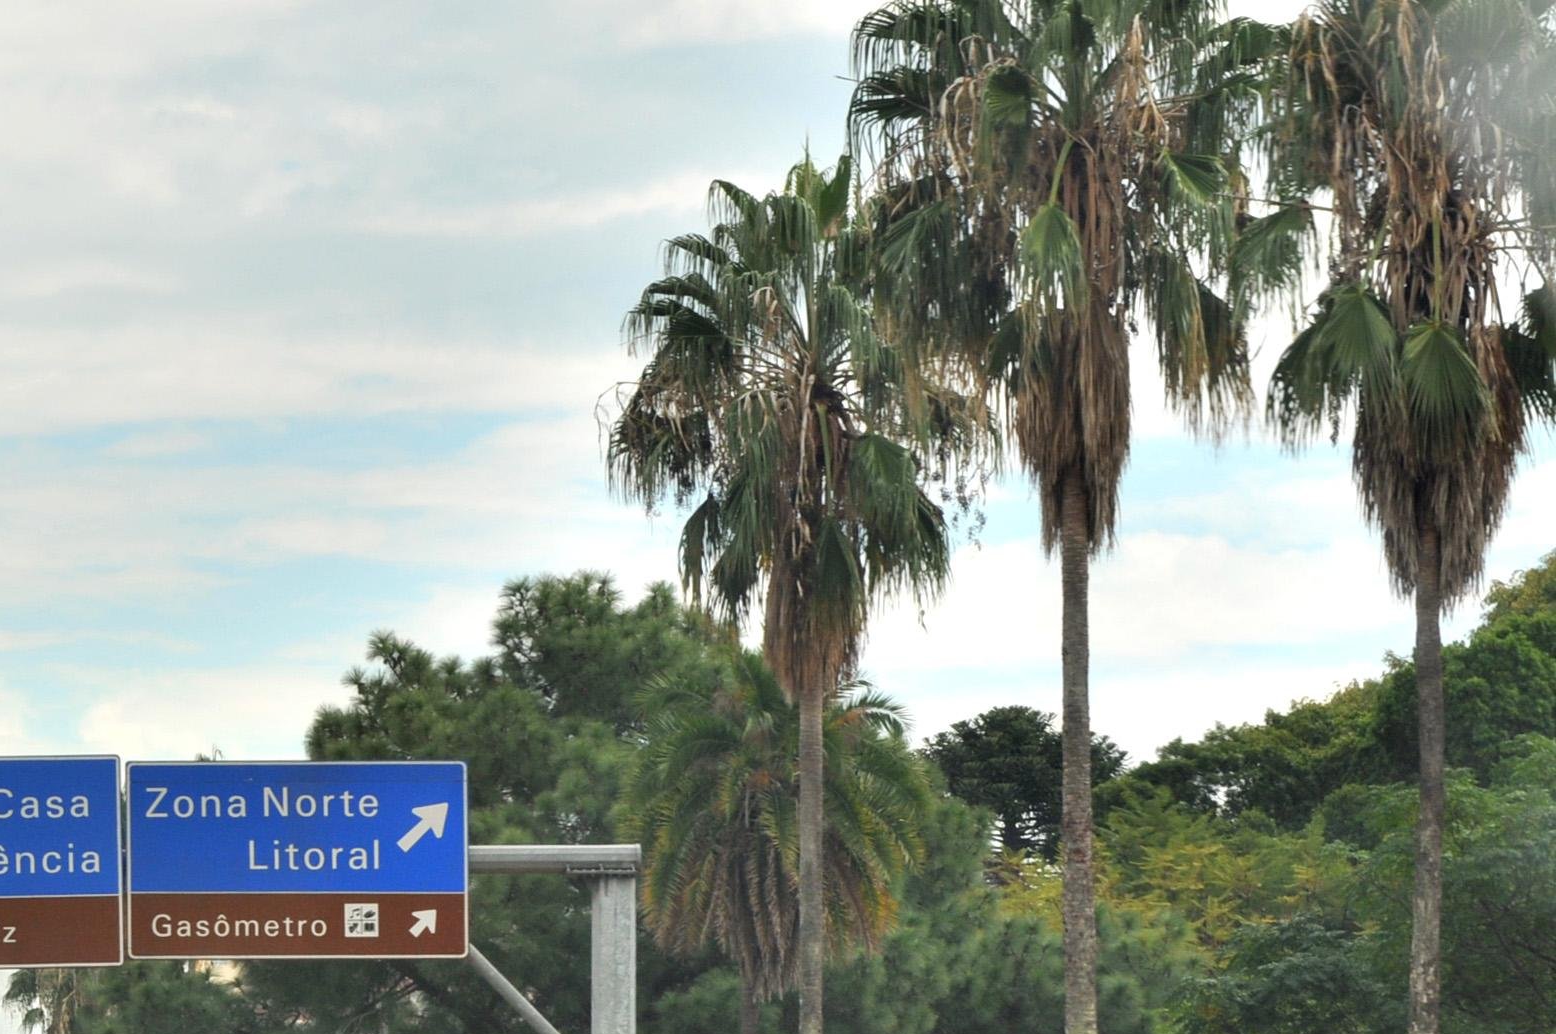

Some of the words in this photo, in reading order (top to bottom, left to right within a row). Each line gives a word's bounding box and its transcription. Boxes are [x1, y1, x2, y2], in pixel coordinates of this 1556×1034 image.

[145, 787, 247, 818] Zona
[263, 786, 379, 818] Norte
[249, 839, 380, 870] Litoral
[151, 913, 328, 938] Gasômetro
